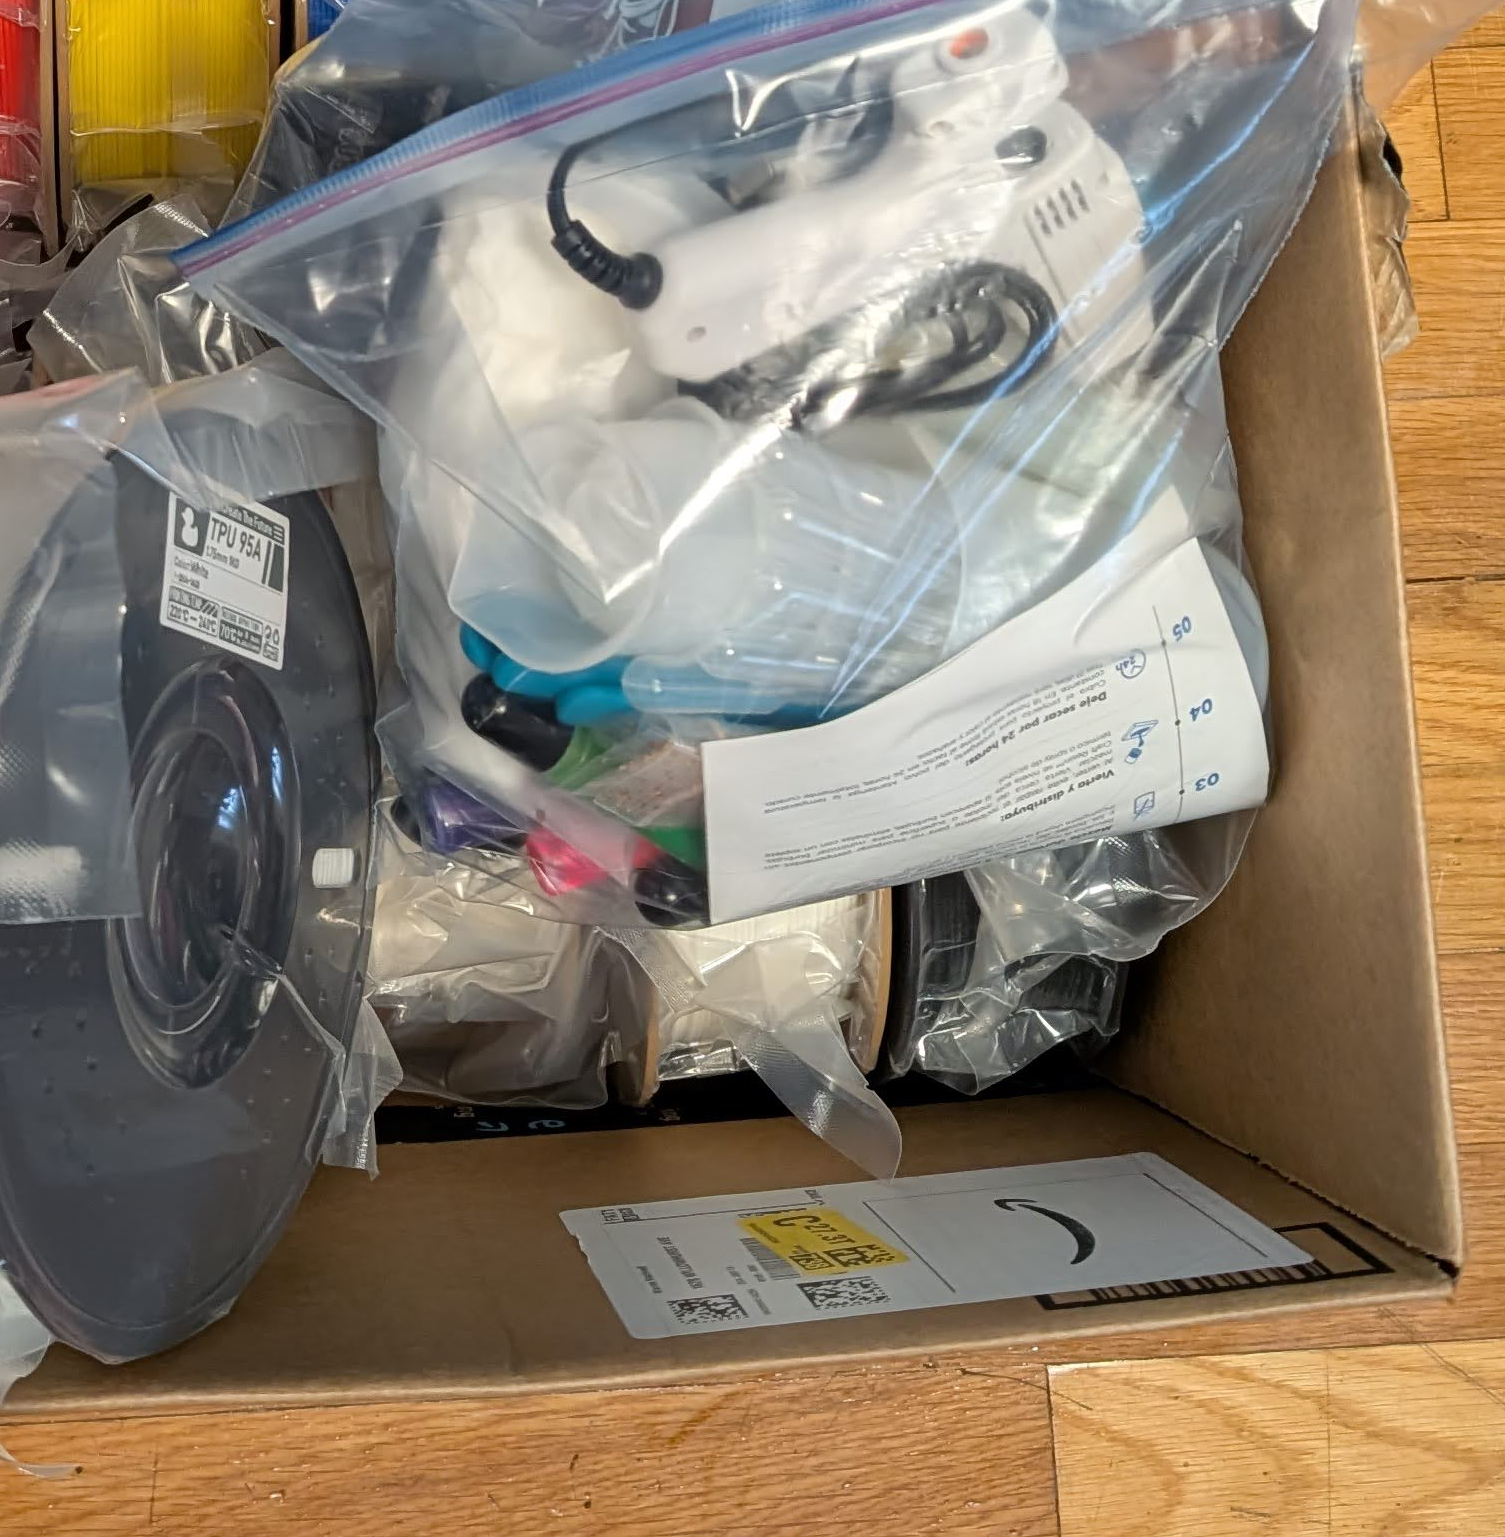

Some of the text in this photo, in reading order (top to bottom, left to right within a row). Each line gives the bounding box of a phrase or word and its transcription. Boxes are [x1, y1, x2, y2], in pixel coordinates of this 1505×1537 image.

[211, 517, 261, 562] TPU 95A
[1173, 615, 1192, 643] 05
[1115, 655, 1136, 671] 24h
[1187, 698, 1213, 722] 04
[965, 691, 1106, 767] Deje secar por 24 horas:
[1000, 769, 1114, 821] Vierta y distribuya:
[1194, 772, 1221, 793] 03
[773, 1215, 856, 1245] C 27.3T
